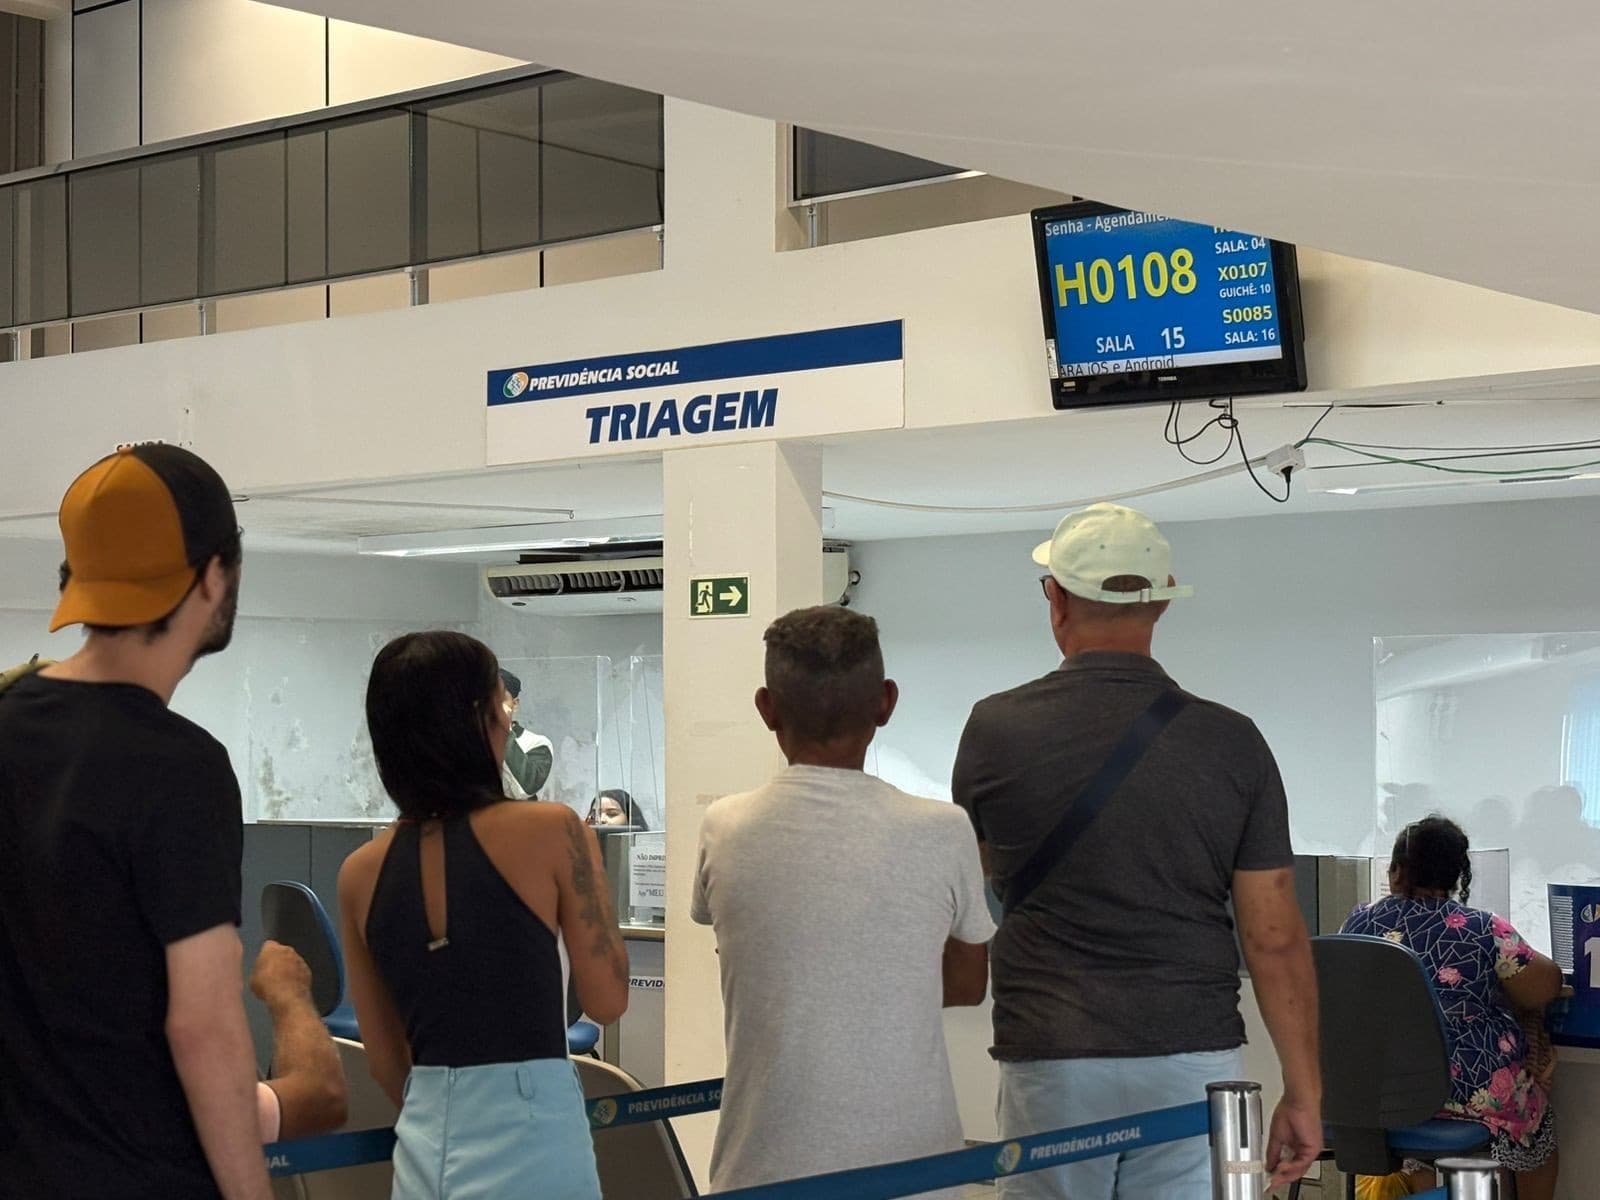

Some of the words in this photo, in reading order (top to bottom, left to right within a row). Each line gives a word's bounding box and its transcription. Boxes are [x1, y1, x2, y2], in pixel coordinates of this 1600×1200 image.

[1045, 220, 1084, 236] Senha
[1214, 239, 1249, 254] SALA:
[1251, 235, 1266, 250] 04
[1055, 248, 1197, 307] H0108
[1217, 262, 1267, 281] X0107
[1219, 282, 1257, 298] GUICHÊ:
[1260, 283, 1271, 294] 10
[1222, 305, 1272, 324] S0085
[1096, 334, 1135, 353] SALA
[1161, 326, 1185, 350] 15
[1224, 330, 1258, 344] SALA:
[1261, 327, 1276, 341] 16
[529, 367, 622, 391] PREVIDÊNCIA
[626, 361, 680, 380] SOCIAL
[1088, 361, 1108, 375] iOS
[1112, 362, 1121, 372] e
[585, 388, 779, 444] TRIAGEM
[628, 1092, 704, 1114] PREVIDÊNCIA
[1030, 1136, 1102, 1160] PREVIDÊNCIA
[1105, 1126, 1141, 1145] SOCIAL
